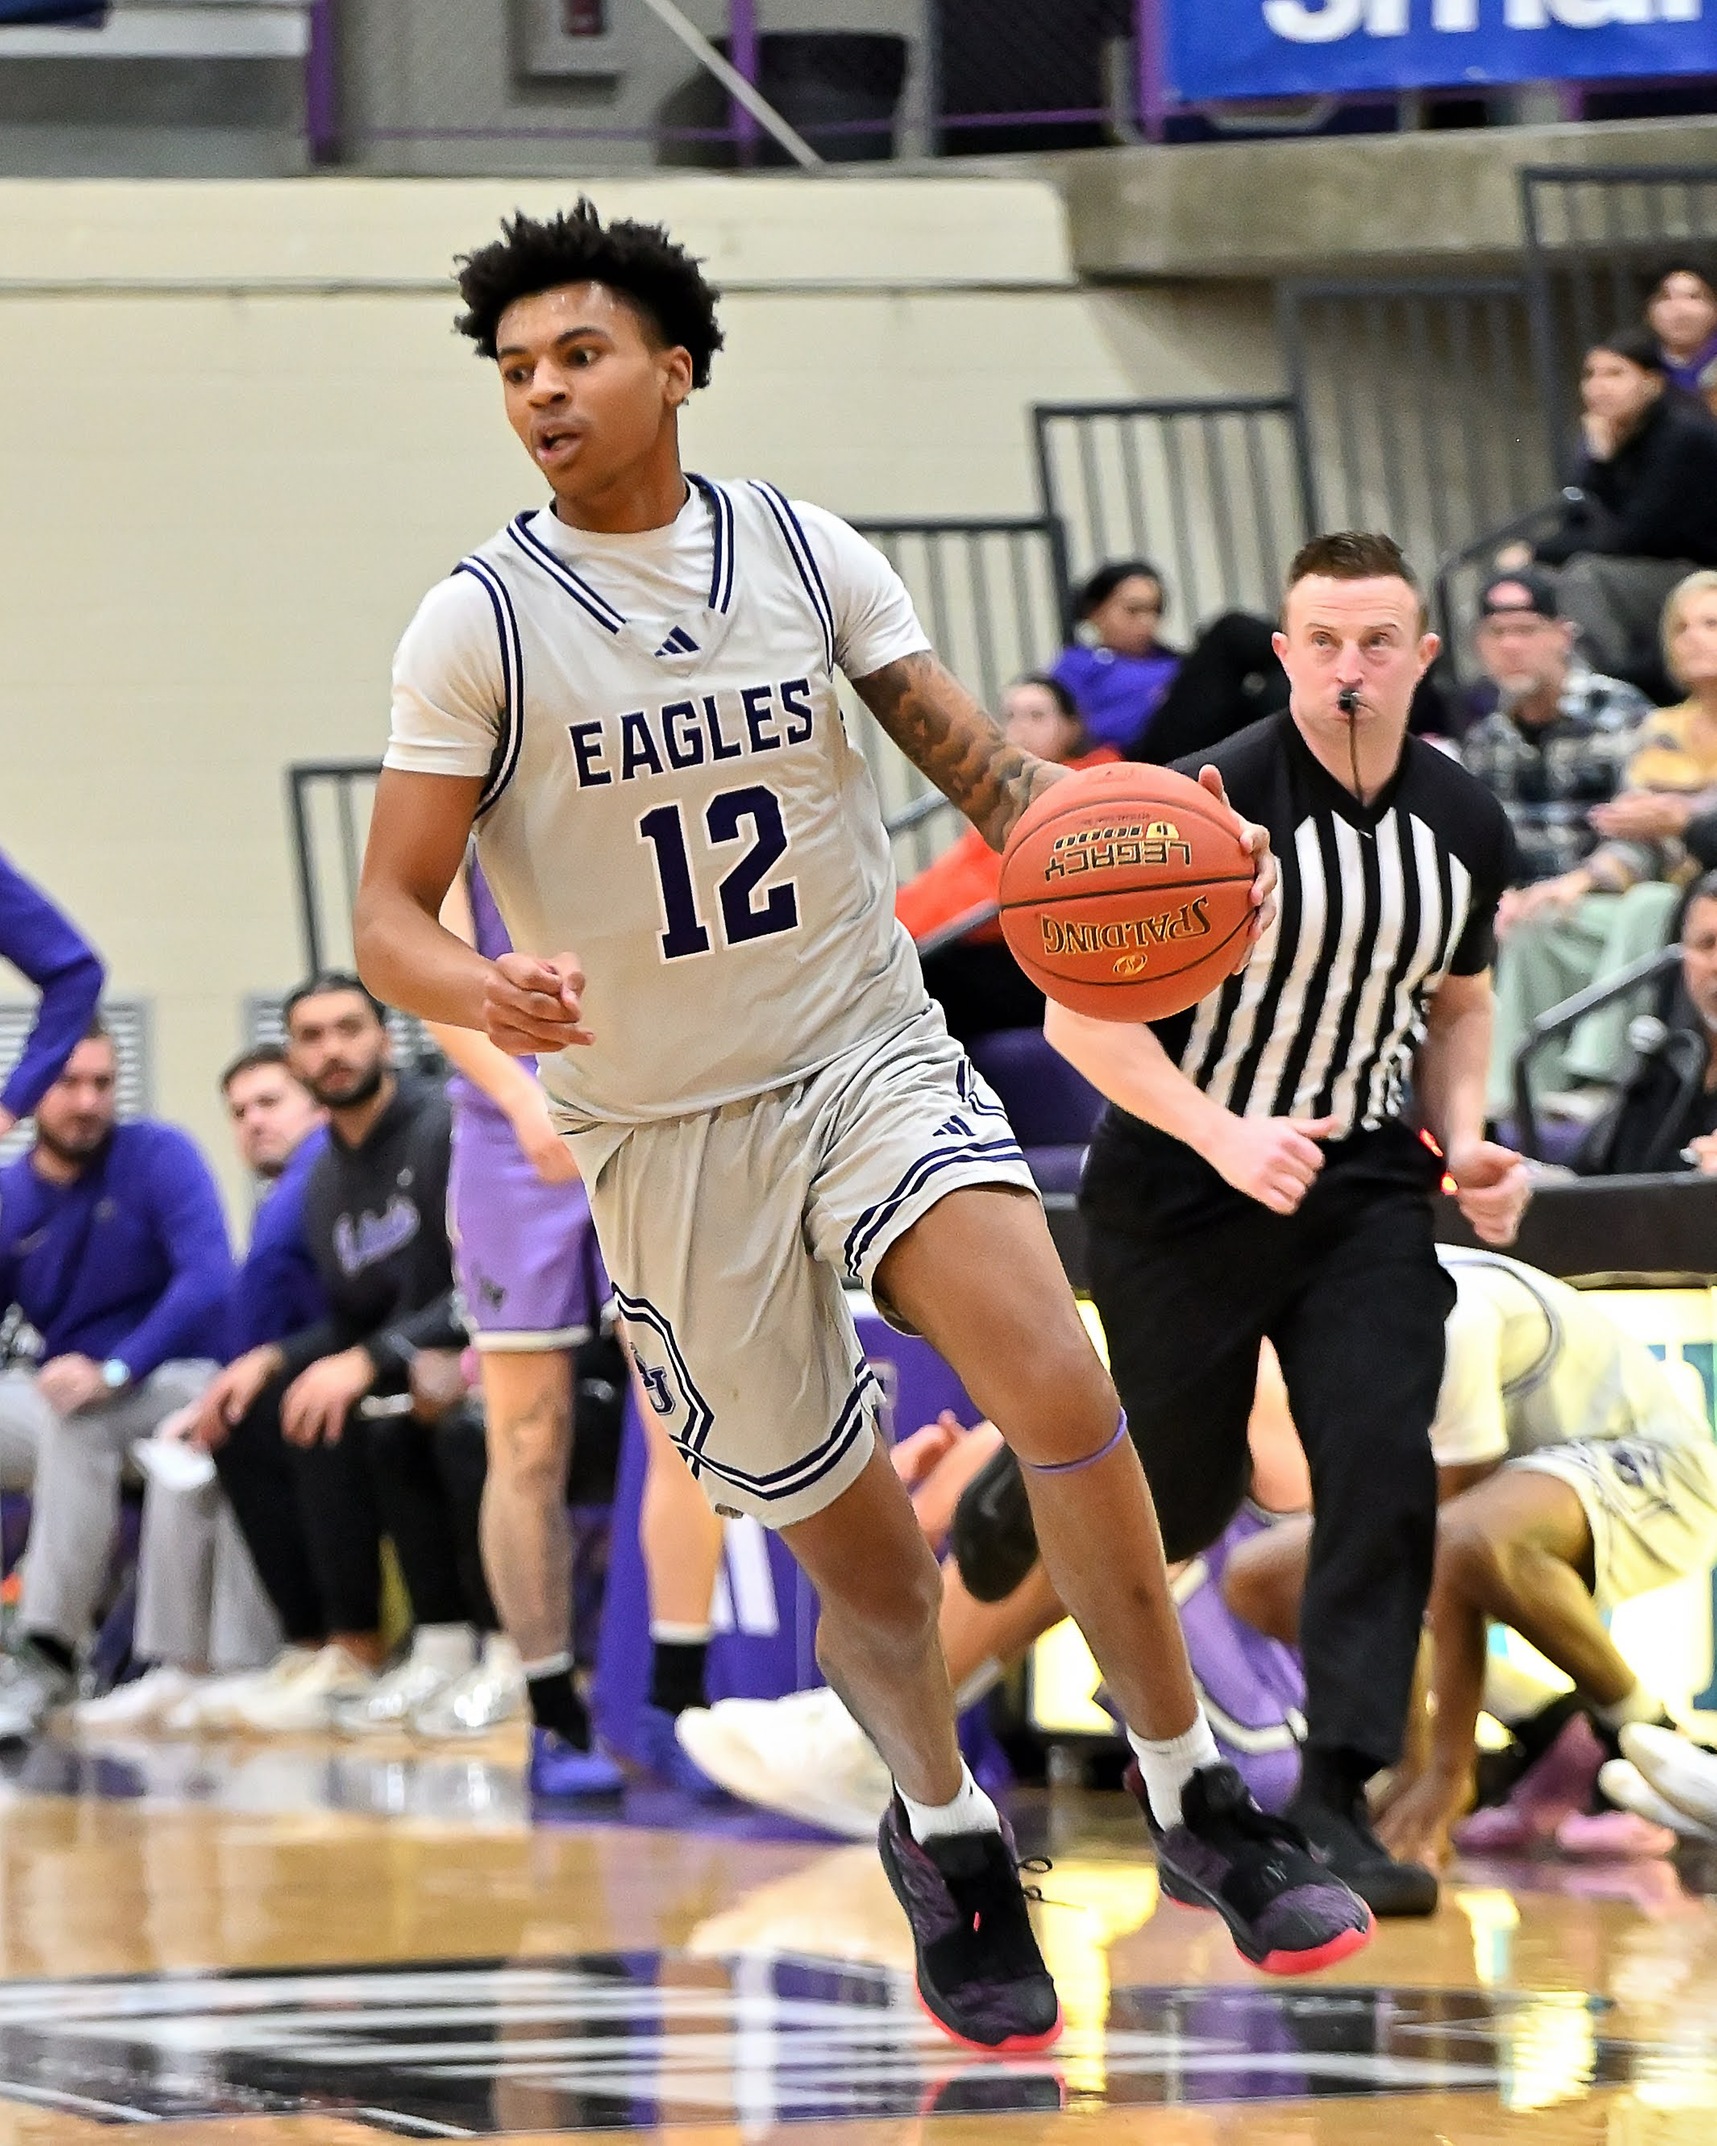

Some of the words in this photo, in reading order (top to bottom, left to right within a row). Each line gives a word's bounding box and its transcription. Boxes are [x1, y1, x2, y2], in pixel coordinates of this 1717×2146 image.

[567, 677, 814, 791] EAGLES
[638, 784, 801, 963] 12
[1045, 840, 1192, 881] LEGACY
[1041, 896, 1211, 955] SPALDING
